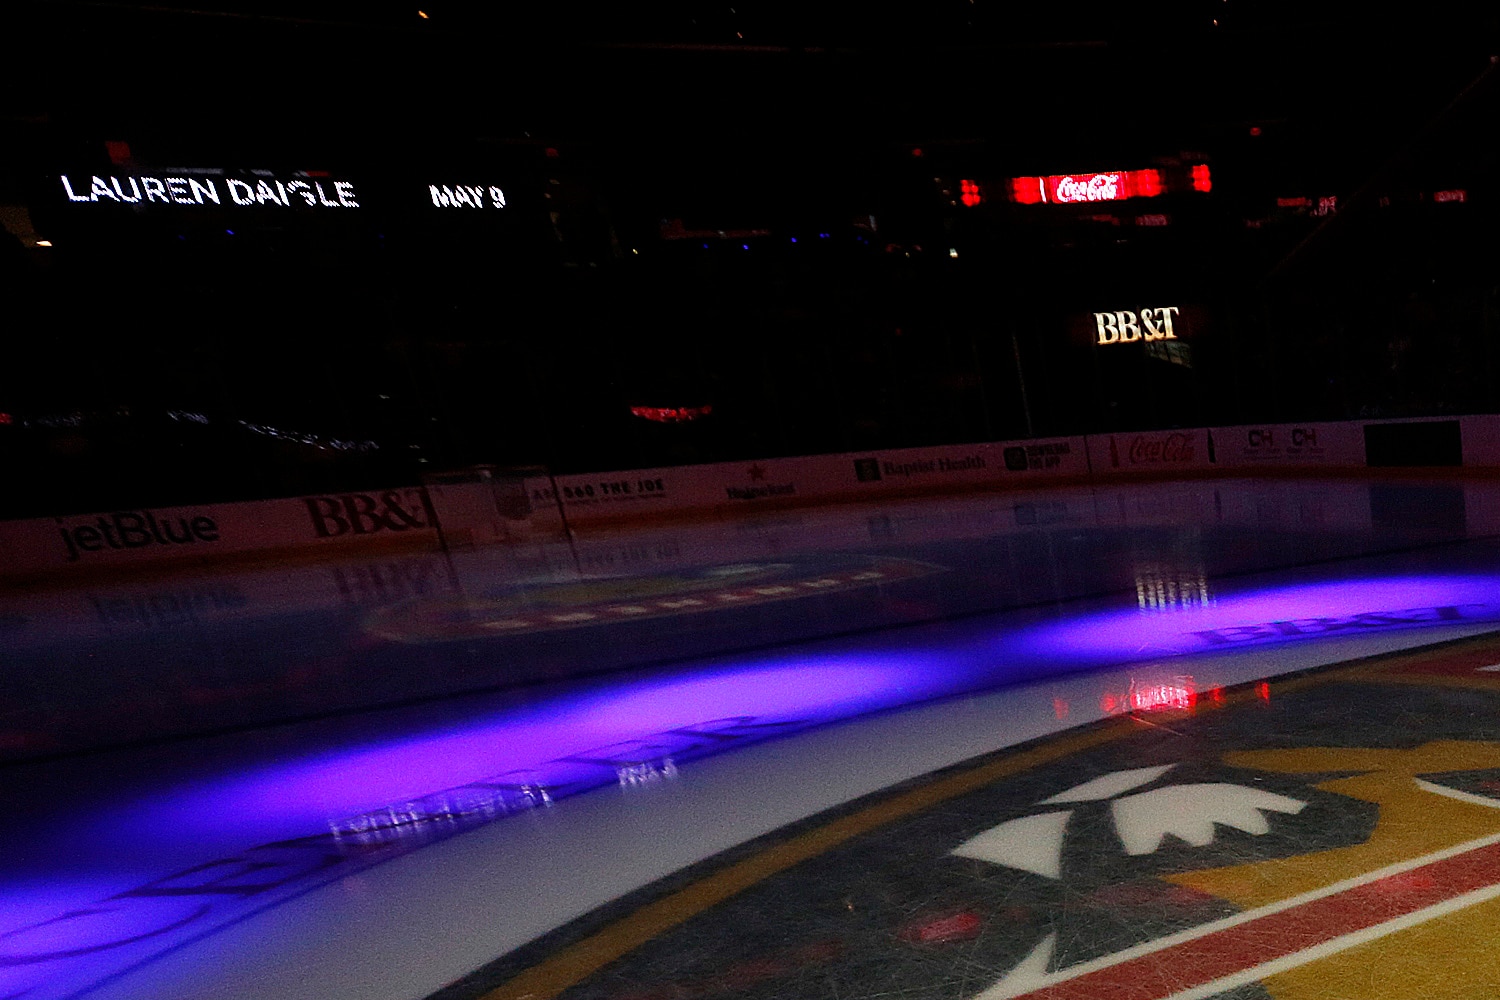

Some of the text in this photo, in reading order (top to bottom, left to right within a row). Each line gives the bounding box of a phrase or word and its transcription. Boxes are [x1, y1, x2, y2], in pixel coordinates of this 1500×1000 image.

[61, 174, 507, 210] LAUREN DAIGLE MAY 9
[1093, 306, 1180, 345] BB&T
[883, 455, 986, 477] Baptist Health
[56, 510, 220, 562] jetBlue
